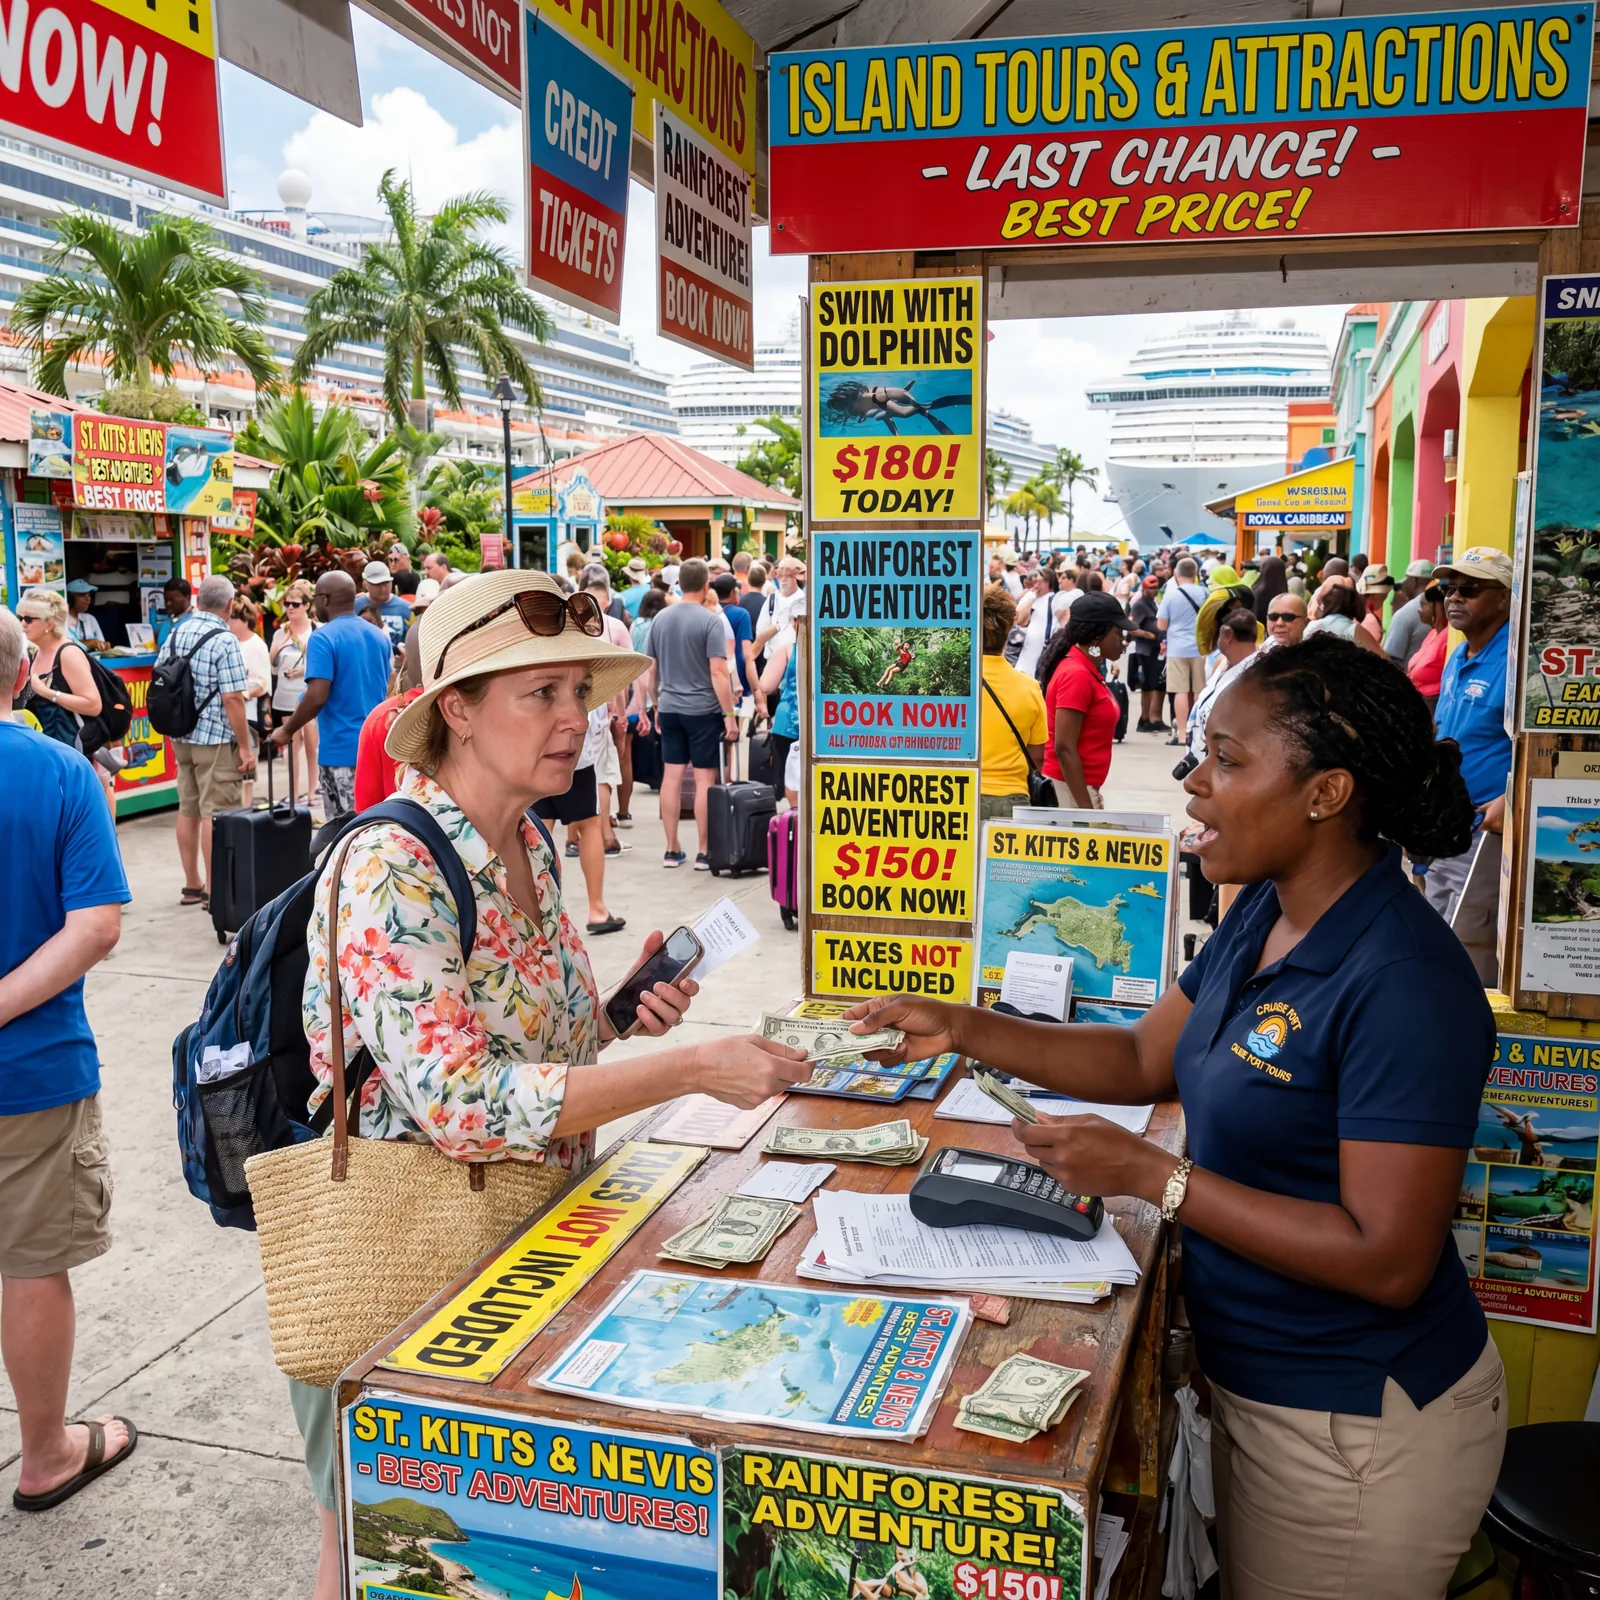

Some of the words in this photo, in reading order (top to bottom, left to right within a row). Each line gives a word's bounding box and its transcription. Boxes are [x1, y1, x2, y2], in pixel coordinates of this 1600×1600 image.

[472, 0, 511, 65] NOT
[787, 54, 963, 137] ISLAND
[975, 42, 1140, 127] TOURS
[1154, 39, 1190, 119] &
[1200, 16, 1571, 116] ATTRACTIONS
[545, 79, 618, 181] CREDT
[663, 120, 748, 229] RAINFOREST
[965, 139, 1103, 192] LAST
[1110, 125, 1359, 187] CHANCE!
[999, 194, 1131, 240] BEST
[1135, 186, 1313, 236] PRICE!
[539, 188, 618, 285] TICKETS
[664, 192, 749, 288] ADVENTURE!
[665, 270, 709, 336] BOOK
[712, 296, 749, 354] NOW!
[819, 289, 894, 327] SWIM
[904, 286, 973, 323] WITH
[1557, 287, 1600, 310] SN
[819, 326, 973, 367] DOLPHINS
[79, 420, 97, 450] ST.
[98, 422, 126, 454] KITTS
[128, 426, 135, 455] &
[136, 427, 164, 457] NEVIS
[832, 443, 961, 483] $180!
[83, 485, 121, 509] BEST
[124, 488, 164, 512] PRICE
[840, 489, 954, 513] TODAY!
[1248, 513, 1282, 525] ROYAL
[1285, 513, 1345, 525] CARIBBEAN
[820, 540, 972, 577] RAINFOREST
[819, 584, 971, 620] ADVENTURE!
[824, 700, 894, 726] BOOK
[902, 702, 967, 728] NOW!
[1535, 707, 1600, 726] BERM
[820, 771, 970, 805] RAINFOREST
[820, 807, 969, 841] ADVENTURE!
[834, 842, 957, 881] $150!
[993, 832, 1019, 855] ST.
[1025, 834, 1080, 860] KITTS
[1086, 838, 1099, 861] &
[1106, 840, 1163, 866] NEVIS
[822, 883, 892, 912] BOOK
[901, 887, 966, 916] NOW!
[825, 939, 903, 965] TAXES
[911, 944, 962, 969] NOT
[832, 966, 955, 995] INCLUDED
[1508, 1042, 1525, 1063] &
[1533, 1044, 1600, 1071] NEVIS
[589, 1149, 684, 1204] TAXES
[544, 1204, 629, 1249] NOT
[416, 1250, 583, 1368] INCLUDED
[894, 1310, 919, 1344] BEST
[920, 1307, 953, 1328] ST.
[901, 1328, 944, 1368] KITTS
[894, 1370, 925, 1381] &
[872, 1383, 921, 1428] NEVIS
[353, 1405, 409, 1447] ST.
[420, 1414, 536, 1468] KITTS
[549, 1436, 578, 1474] &
[591, 1441, 714, 1495] NEVIS
[377, 1453, 461, 1496] BEST
[468, 1469, 709, 1537] ADVENTURES!
[743, 1454, 1059, 1529] RAINFOREST
[751, 1496, 1056, 1569] ADVENTURE!
[955, 1561, 1062, 1600] $150!
